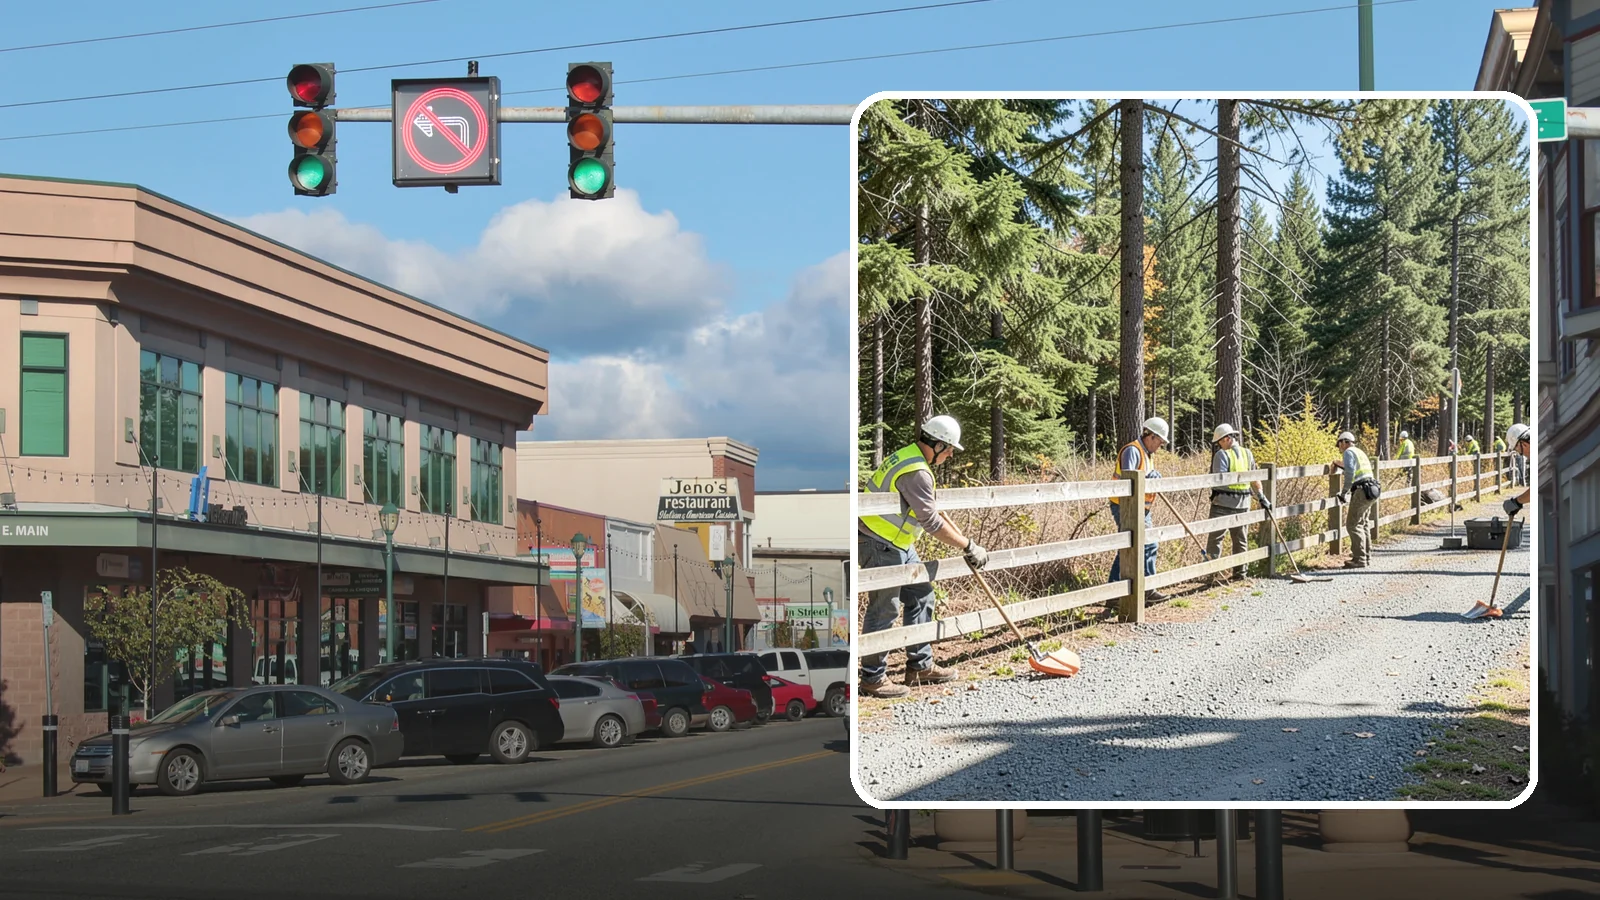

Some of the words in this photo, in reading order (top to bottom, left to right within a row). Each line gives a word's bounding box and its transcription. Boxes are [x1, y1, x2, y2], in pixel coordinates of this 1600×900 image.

[670, 480, 727, 494] Jeno's
[665, 496, 731, 509] restaurant
[686, 509, 714, 519] American
[715, 509, 737, 519] Cuisine
[2, 525, 13, 536] E.
[15, 525, 49, 536] MAIN
[797, 607, 828, 617] Street
